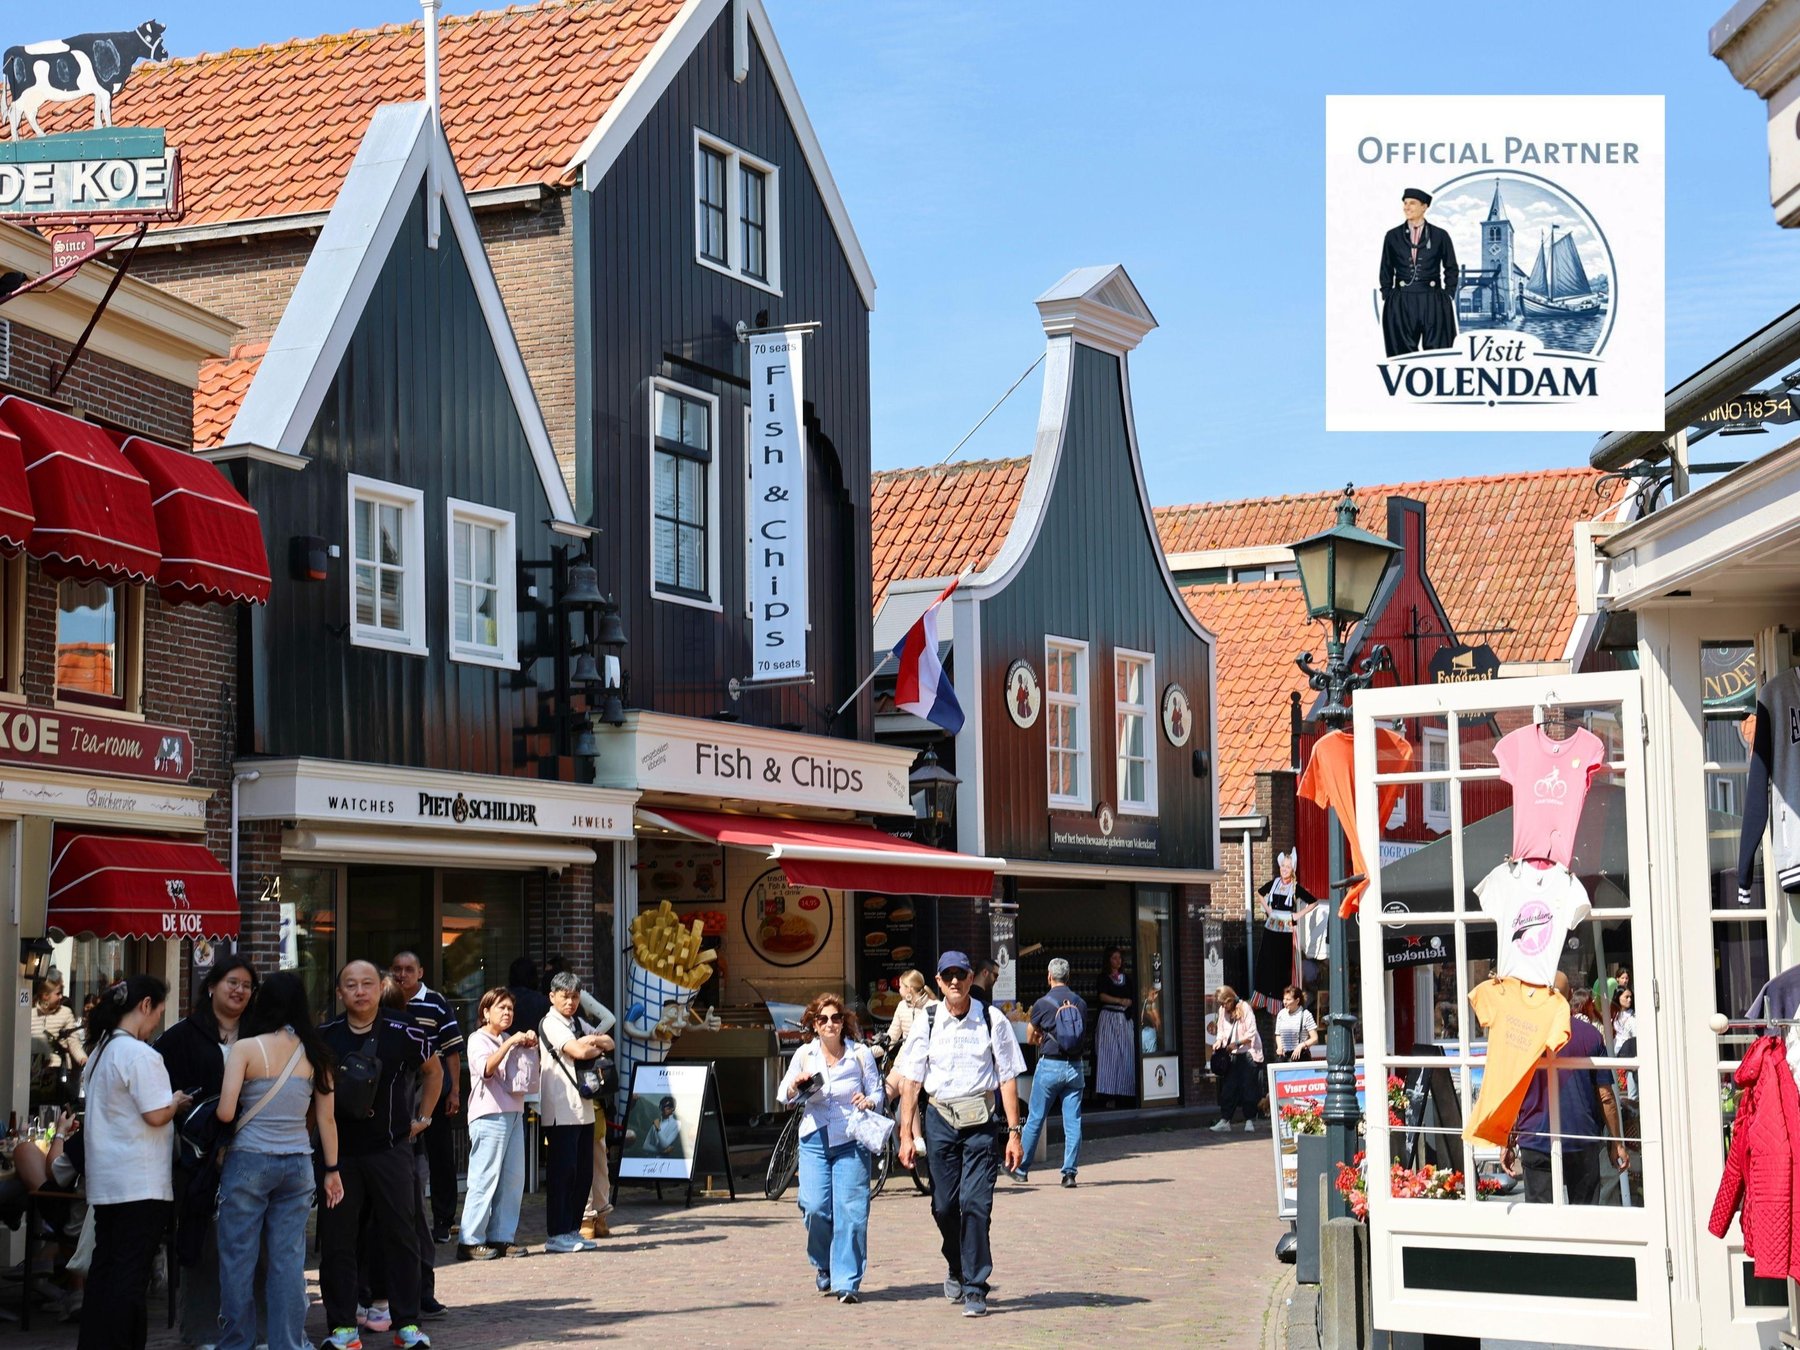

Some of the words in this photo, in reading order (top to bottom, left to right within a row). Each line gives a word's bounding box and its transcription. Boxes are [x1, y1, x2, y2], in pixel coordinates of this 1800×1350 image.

[0, 164, 55, 206] DE
[72, 159, 167, 203] KOE
[54, 240, 86, 253] Since
[754, 345, 766, 354] 70
[769, 343, 797, 353] seats
[764, 365, 787, 464] Fish
[763, 485, 790, 503] &
[760, 519, 791, 648] Chips
[758, 661, 770, 671] 70
[773, 659, 801, 670] seats
[71, 726, 143, 760] Tea-room
[696, 743, 751, 780] Fish
[763, 757, 781, 783] &
[792, 756, 863, 794] Chips
[328, 796, 394, 813] WATCHES
[418, 792, 452, 816] PIET
[469, 799, 538, 826] SCHILDER
[572, 815, 613, 829] JEWELS
[1067, 833, 1076, 844] het
[1076, 834, 1085, 845] best
[1125, 840, 1133, 848] van
[260, 876, 281, 902] 24
[163, 914, 176, 932] DE
[180, 914, 202, 932] KOE
[1513, 911, 1553, 928] Amsterdam
[20, 991, 29, 1003] 26
[1284, 1084, 1307, 1094] VISIT
[1308, 1083, 1327, 1092] OUR
